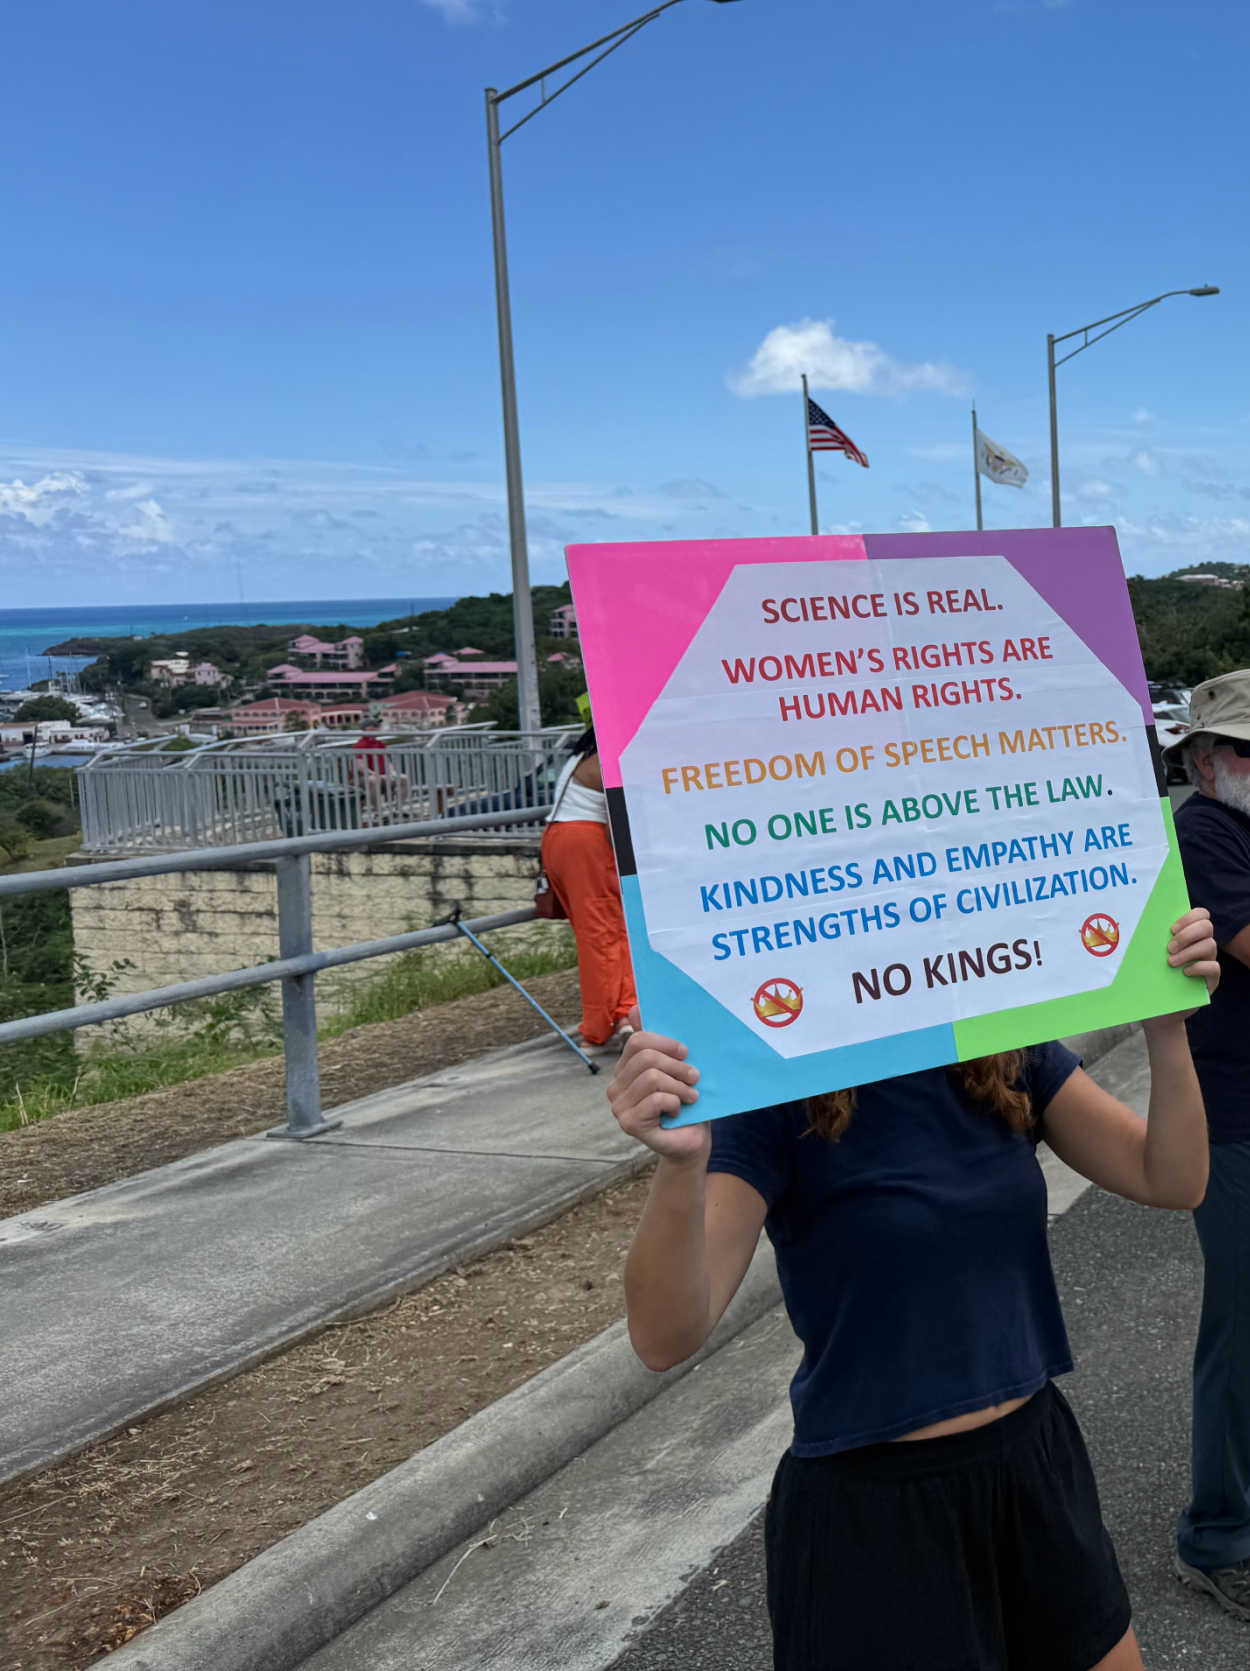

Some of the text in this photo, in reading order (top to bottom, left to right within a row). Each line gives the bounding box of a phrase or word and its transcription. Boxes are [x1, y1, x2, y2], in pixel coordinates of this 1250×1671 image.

[761, 587, 1004, 625] SCIENCE IS REAL.
[720, 636, 1054, 685] WOMEN’S RIGHTS ARE
[778, 676, 1022, 723] HUMAN RIGHTS.
[660, 720, 1128, 796] FREEDOM OF SPEECH MATTERS.
[704, 773, 1114, 851] NO ONE IS ABOVE THE LAW.
[699, 822, 1134, 914] KINDNESS AND EMPATHY ARE
[711, 862, 1138, 962] STRENGTHS OF CIVILIZATION.
[851, 938, 1044, 1006] NO KINGS!
